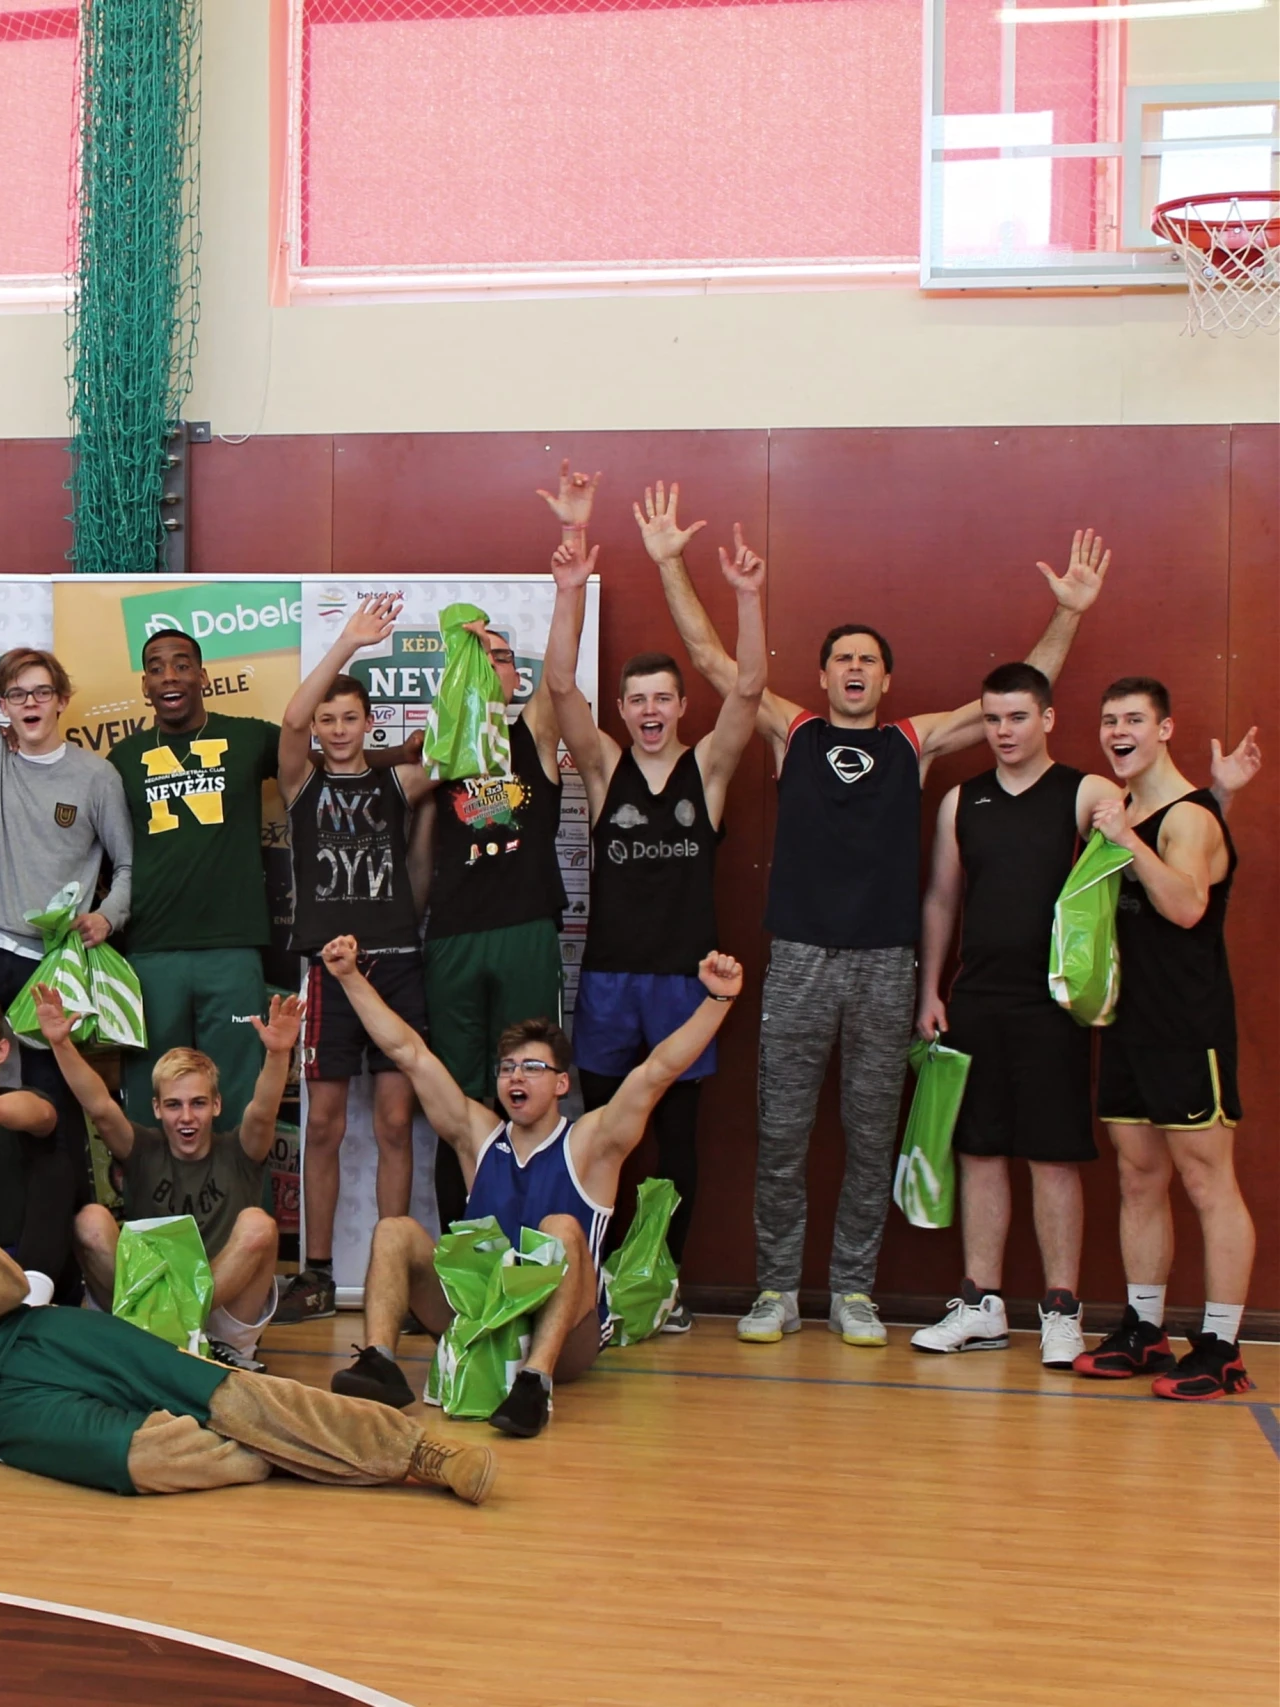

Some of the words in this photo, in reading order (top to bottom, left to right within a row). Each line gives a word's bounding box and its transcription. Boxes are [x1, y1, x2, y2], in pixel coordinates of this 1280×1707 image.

[191, 597, 302, 639] Dobele
[145, 773, 226, 803] NEVĖŽIS
[633, 838, 700, 859] Dobele
